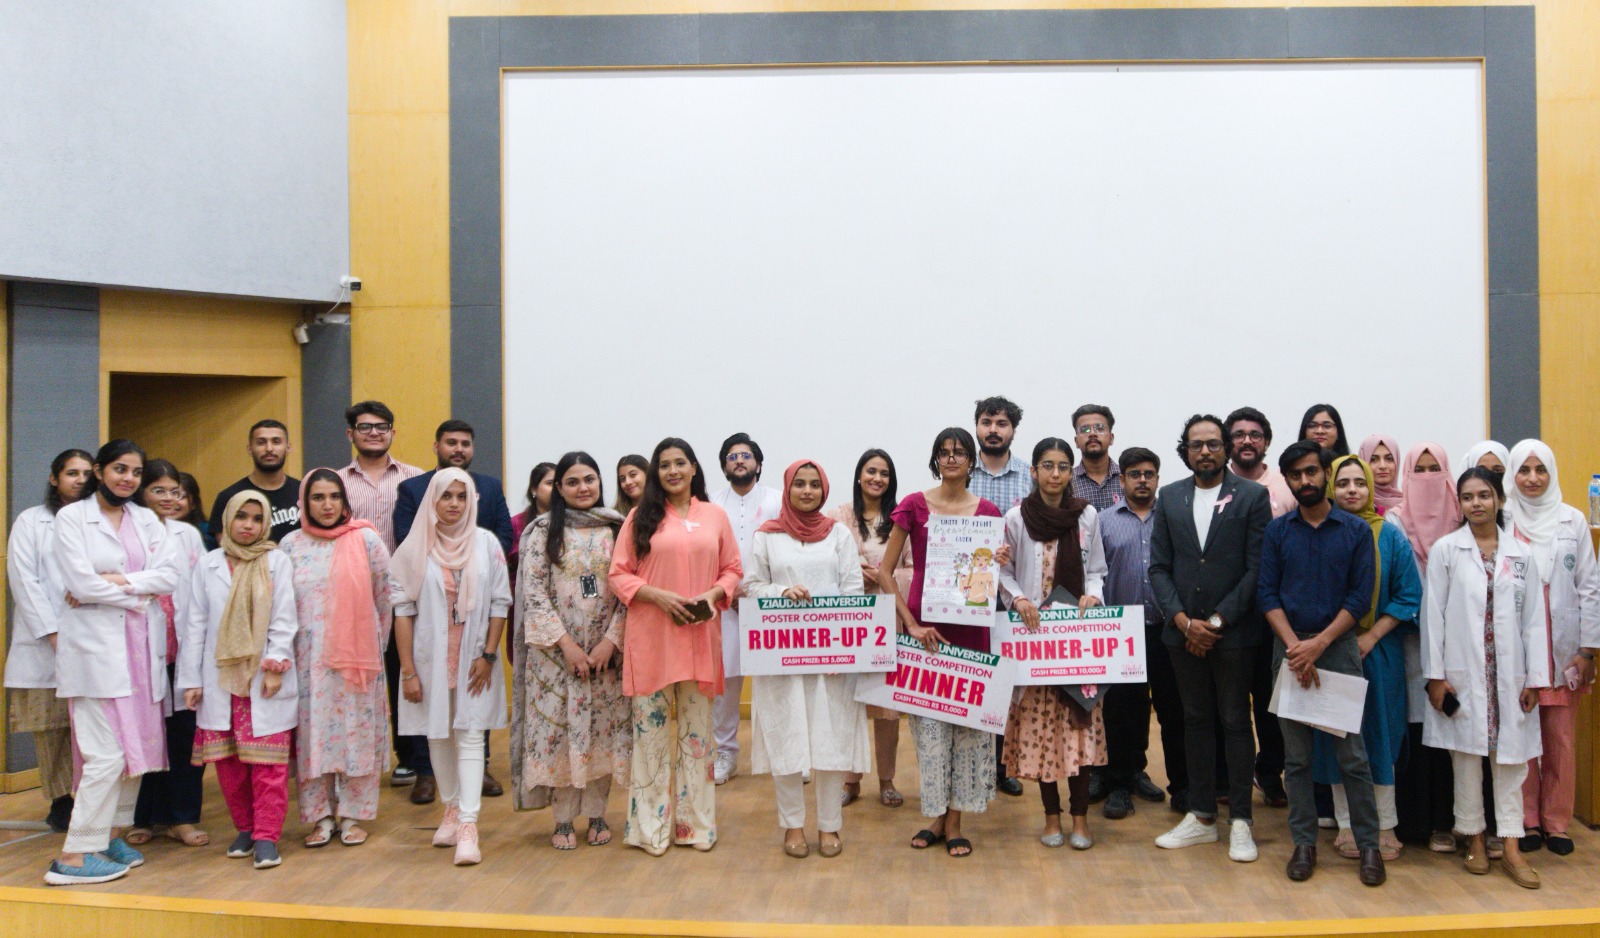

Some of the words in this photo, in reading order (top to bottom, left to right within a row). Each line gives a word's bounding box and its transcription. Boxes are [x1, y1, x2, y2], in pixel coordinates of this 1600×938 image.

[972, 520, 992, 528] FIGHT
[762, 597, 813, 609] ZIAUDDIN
[814, 596, 872, 608] UNIVERSITY
[762, 614, 799, 623] POSTER
[803, 612, 872, 622] COMPETITION
[749, 627, 868, 650] RUNNER-UP
[874, 626, 887, 646] 2
[1012, 625, 1049, 636] POSER
[1052, 623, 1121, 634] COMPETITION
[939, 643, 996, 664] UNIVERSITY
[1001, 637, 1119, 661] RUNNER-UP
[1125, 637, 1135, 656] 1
[925, 656, 993, 679] COMPETITION
[884, 663, 986, 706] WINNER
[894, 693, 911, 703] CASH
[912, 697, 930, 708] PRIZE:
[931, 701, 939, 709] RS
